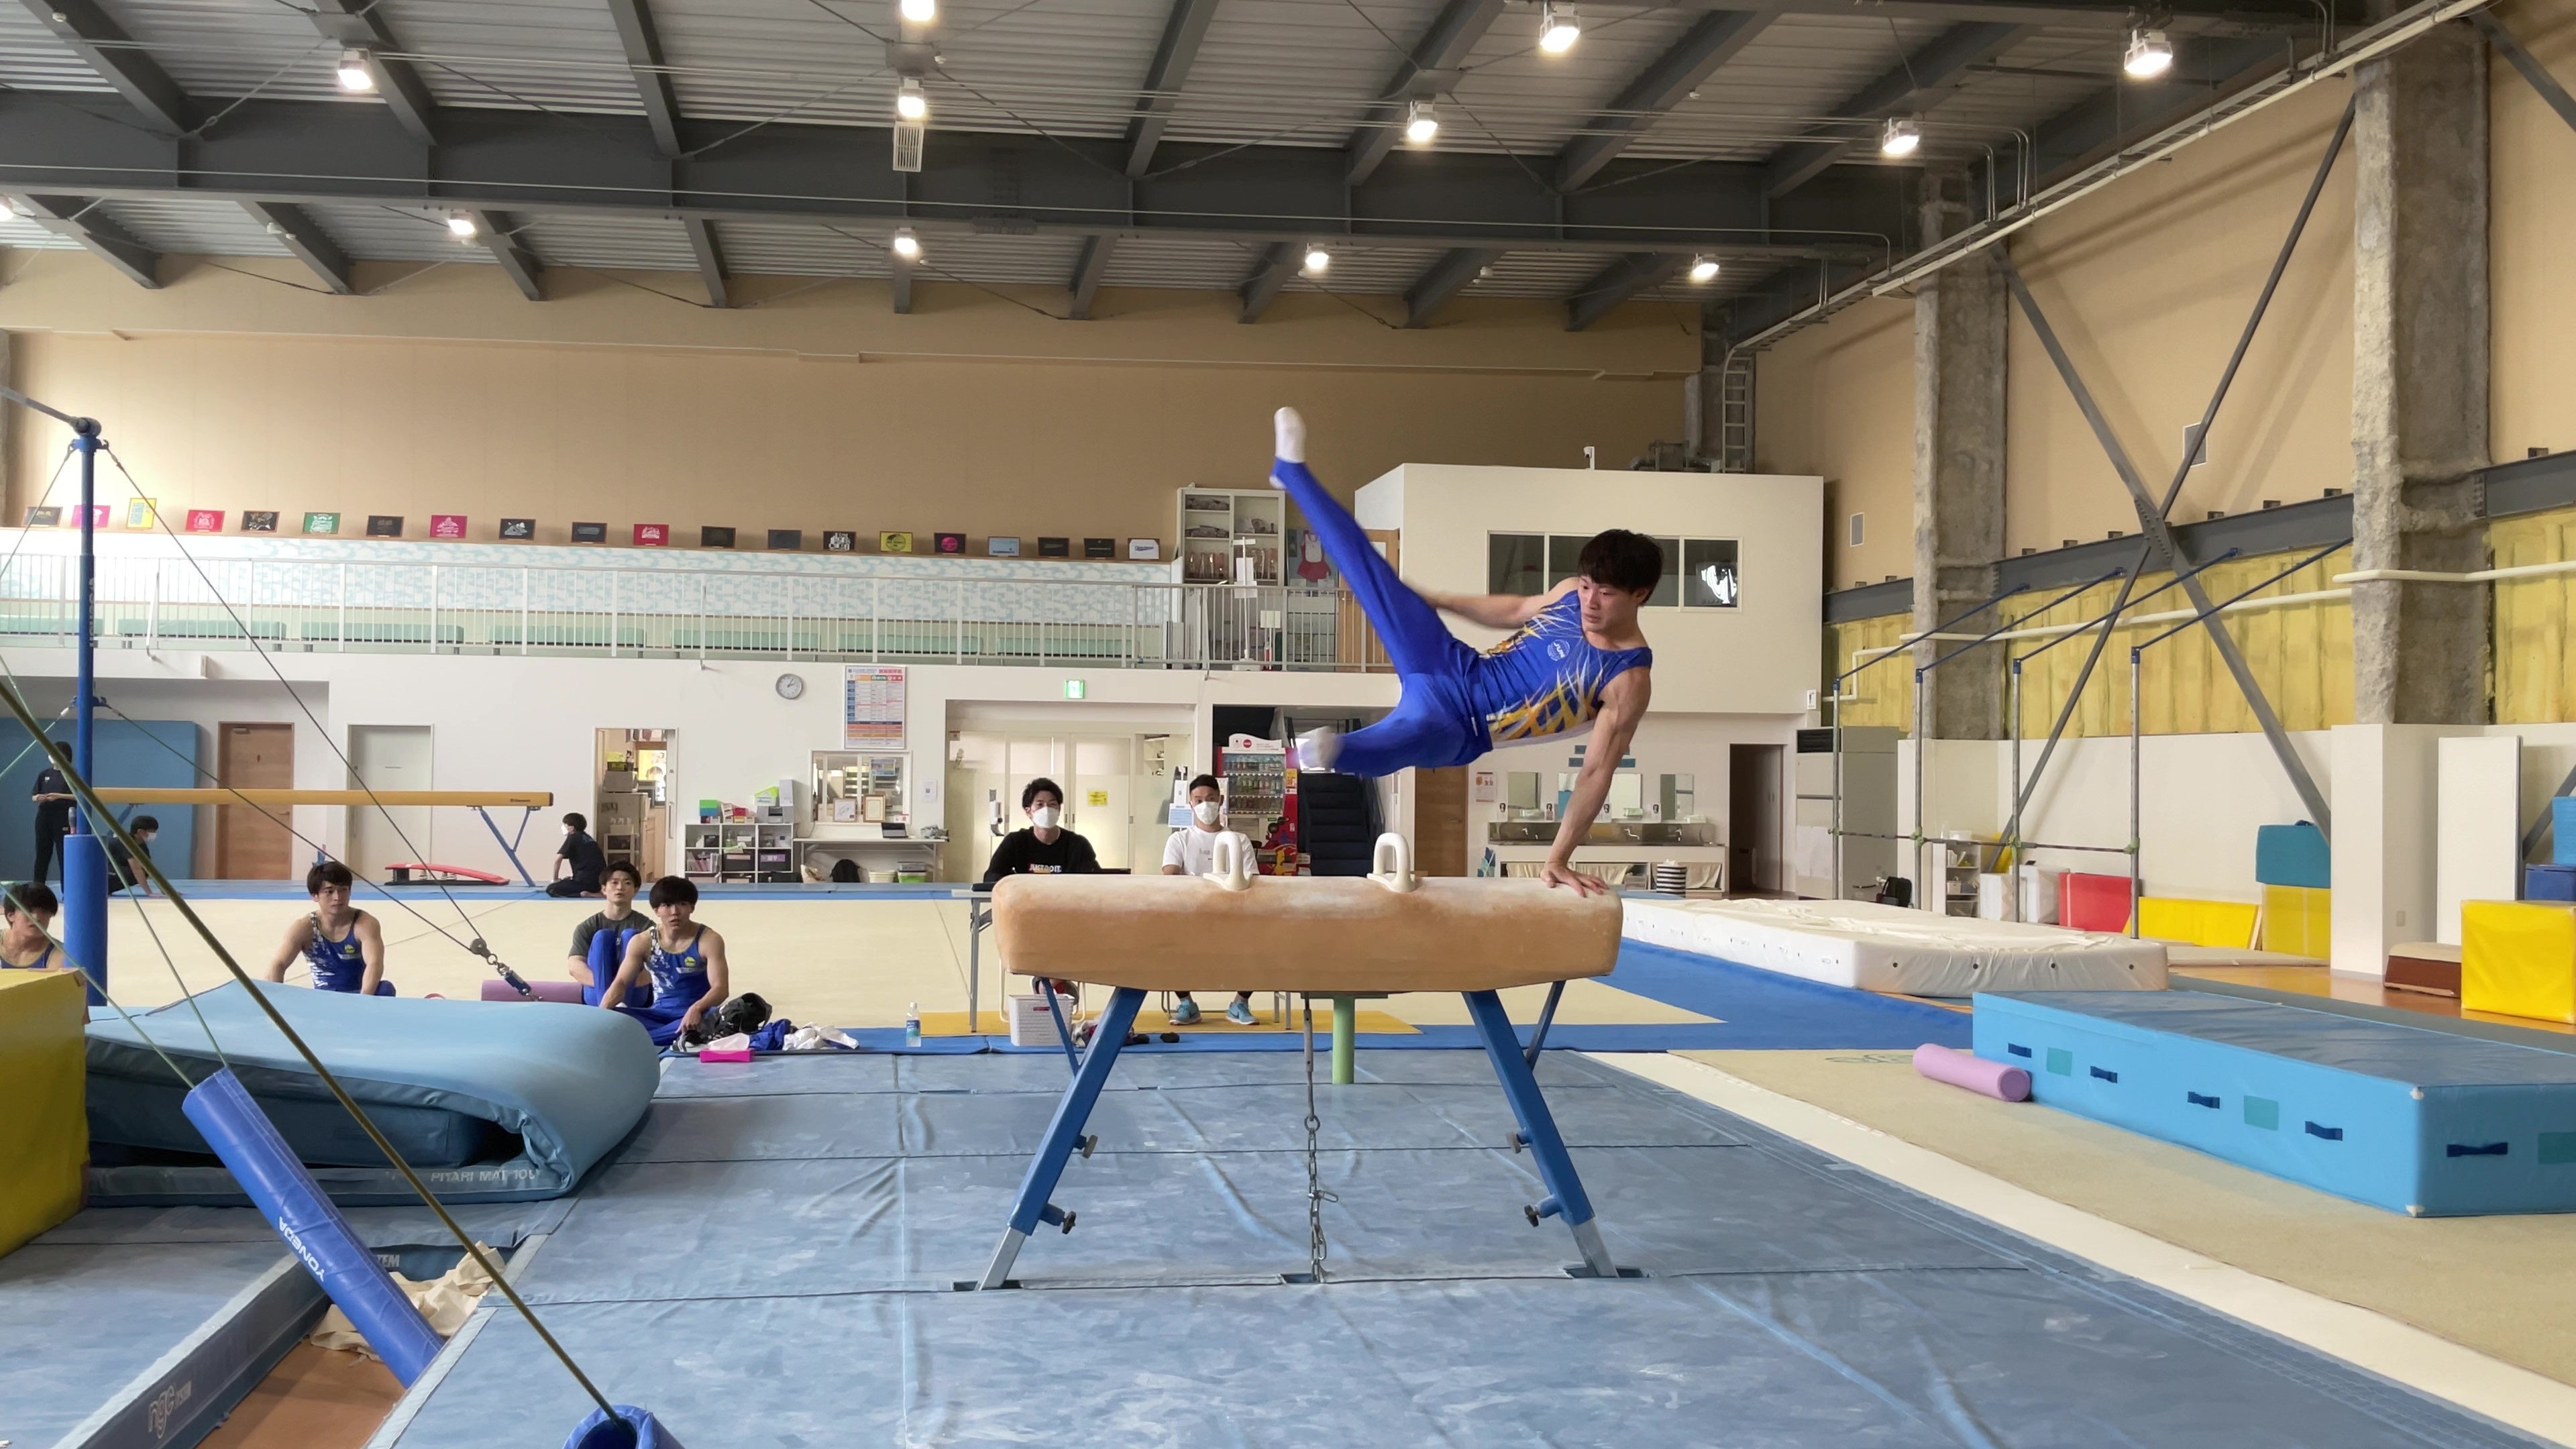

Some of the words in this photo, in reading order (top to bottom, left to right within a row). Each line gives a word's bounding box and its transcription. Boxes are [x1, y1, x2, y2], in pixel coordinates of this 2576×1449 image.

[1029, 863, 1044, 871] JUST
[431, 1171, 474, 1182] PITARI
[479, 1169, 508, 1181] MAT
[279, 1216, 325, 1282] YONEDA
